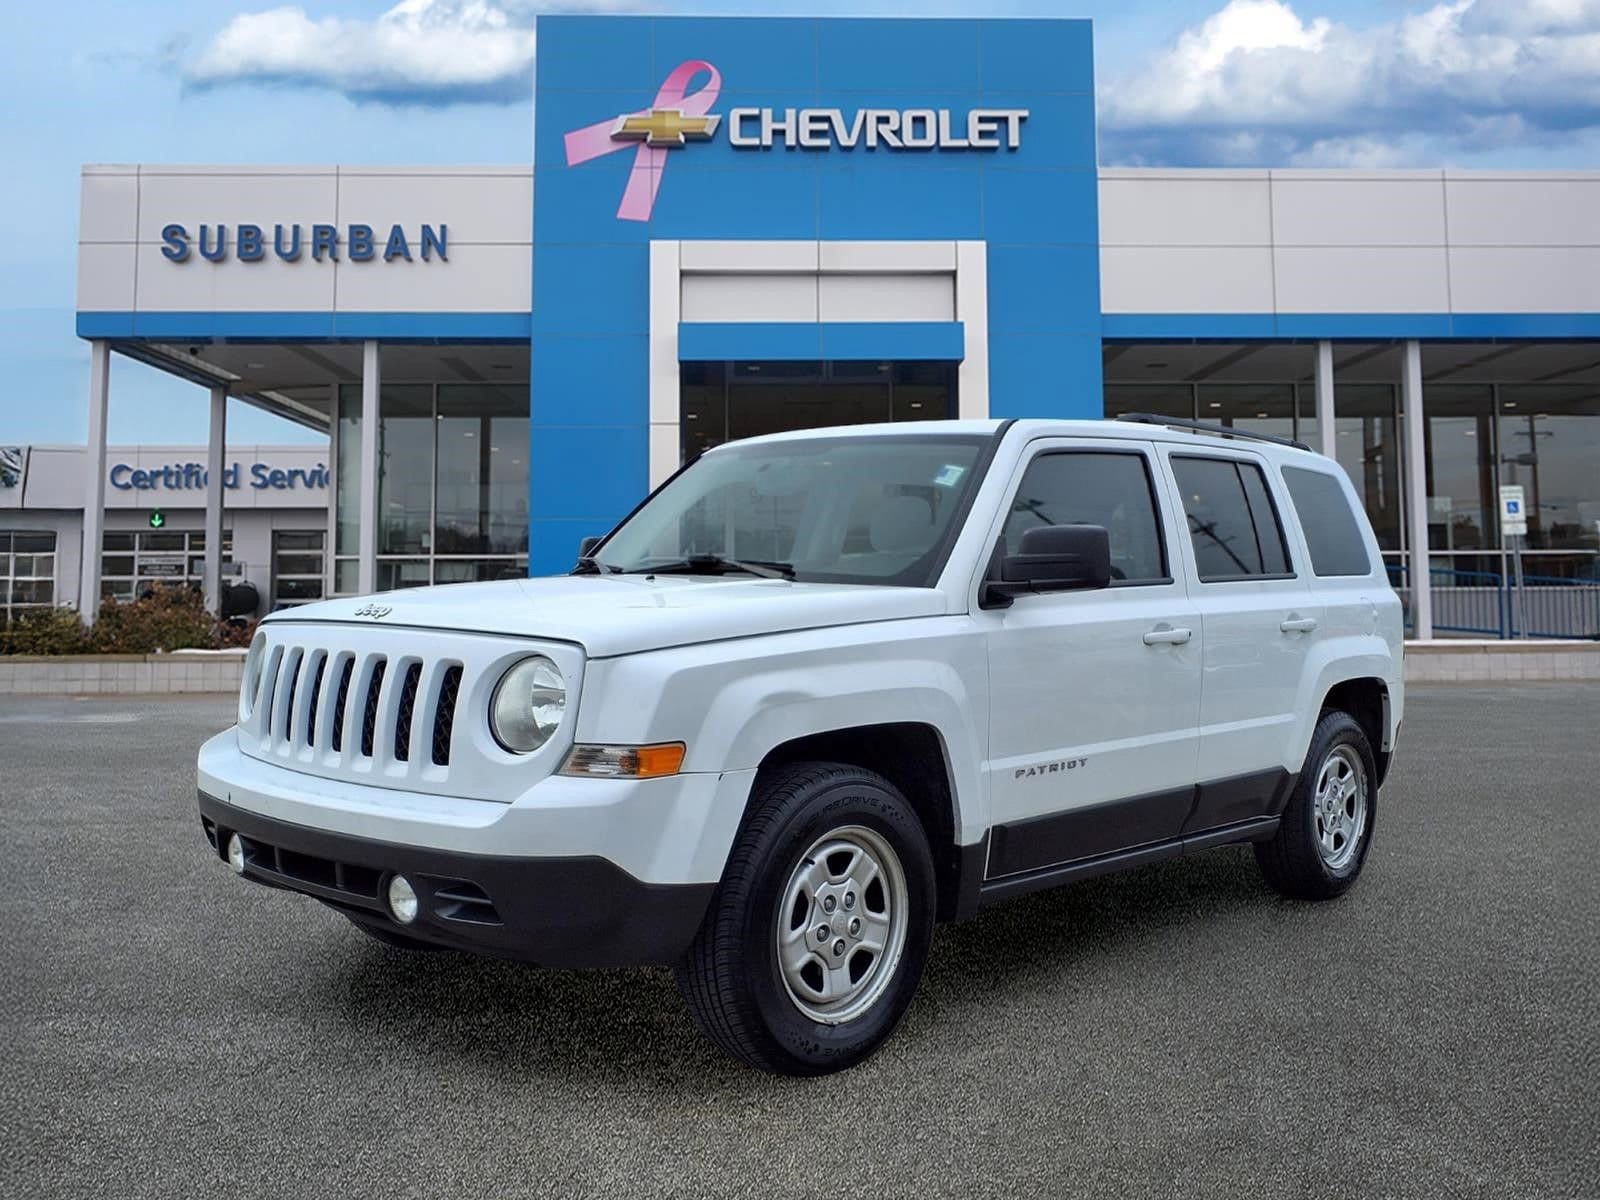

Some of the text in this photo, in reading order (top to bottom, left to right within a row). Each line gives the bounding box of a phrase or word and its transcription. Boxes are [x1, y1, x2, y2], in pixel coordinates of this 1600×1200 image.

[729, 107, 1030, 149] CHEVROLET
[160, 223, 449, 263] SUBURBAN
[110, 463, 240, 490] Certifid
[353, 602, 393, 620] Jeep
[1014, 757, 1089, 780] PATRIOT
